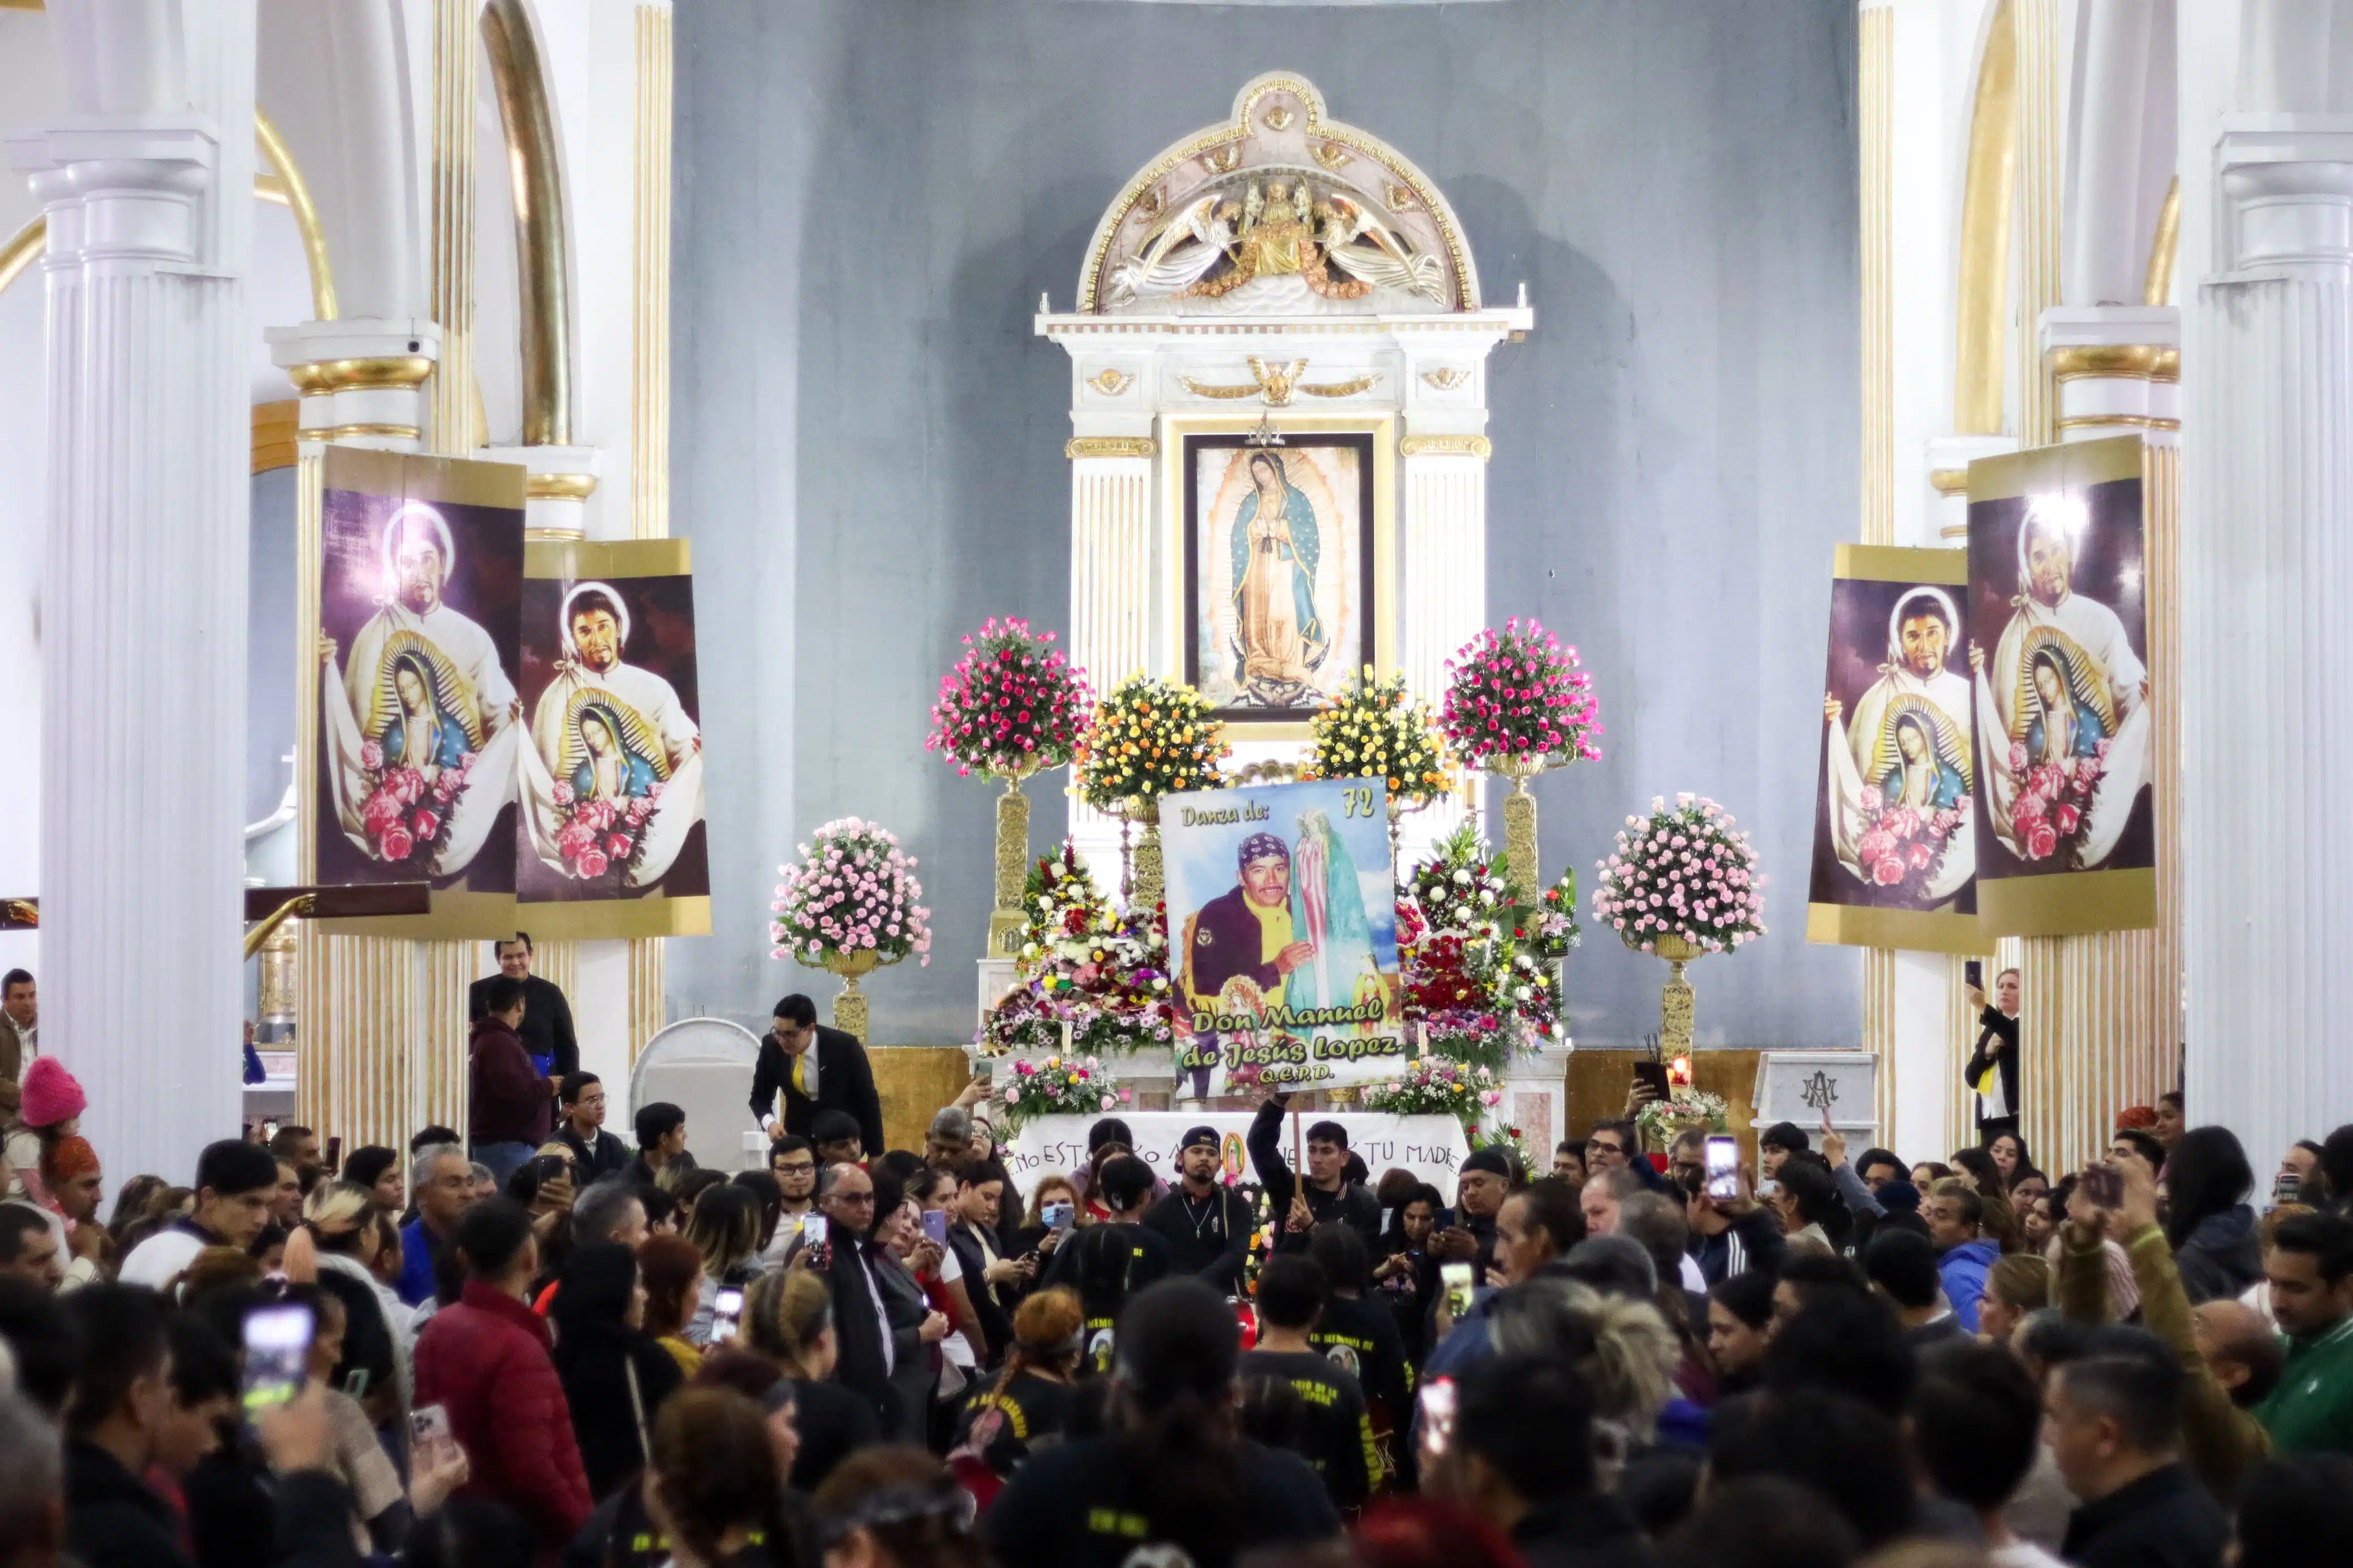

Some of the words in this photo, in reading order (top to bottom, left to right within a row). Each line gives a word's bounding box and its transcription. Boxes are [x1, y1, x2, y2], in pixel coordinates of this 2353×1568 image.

[1180, 805, 1239, 826] Danza
[1244, 800, 1269, 820] de:
[1342, 787, 1374, 818] 72
[1191, 1010, 1253, 1034] Don
[1261, 997, 1384, 1029] Manuel
[1182, 1044, 1219, 1069] de
[1222, 1038, 1307, 1069] Jesús
[1313, 1035, 1404, 1062] Lopez.
[1364, 1141, 1393, 1165] TU
[1324, 1334, 1360, 1348] MEMORIA
